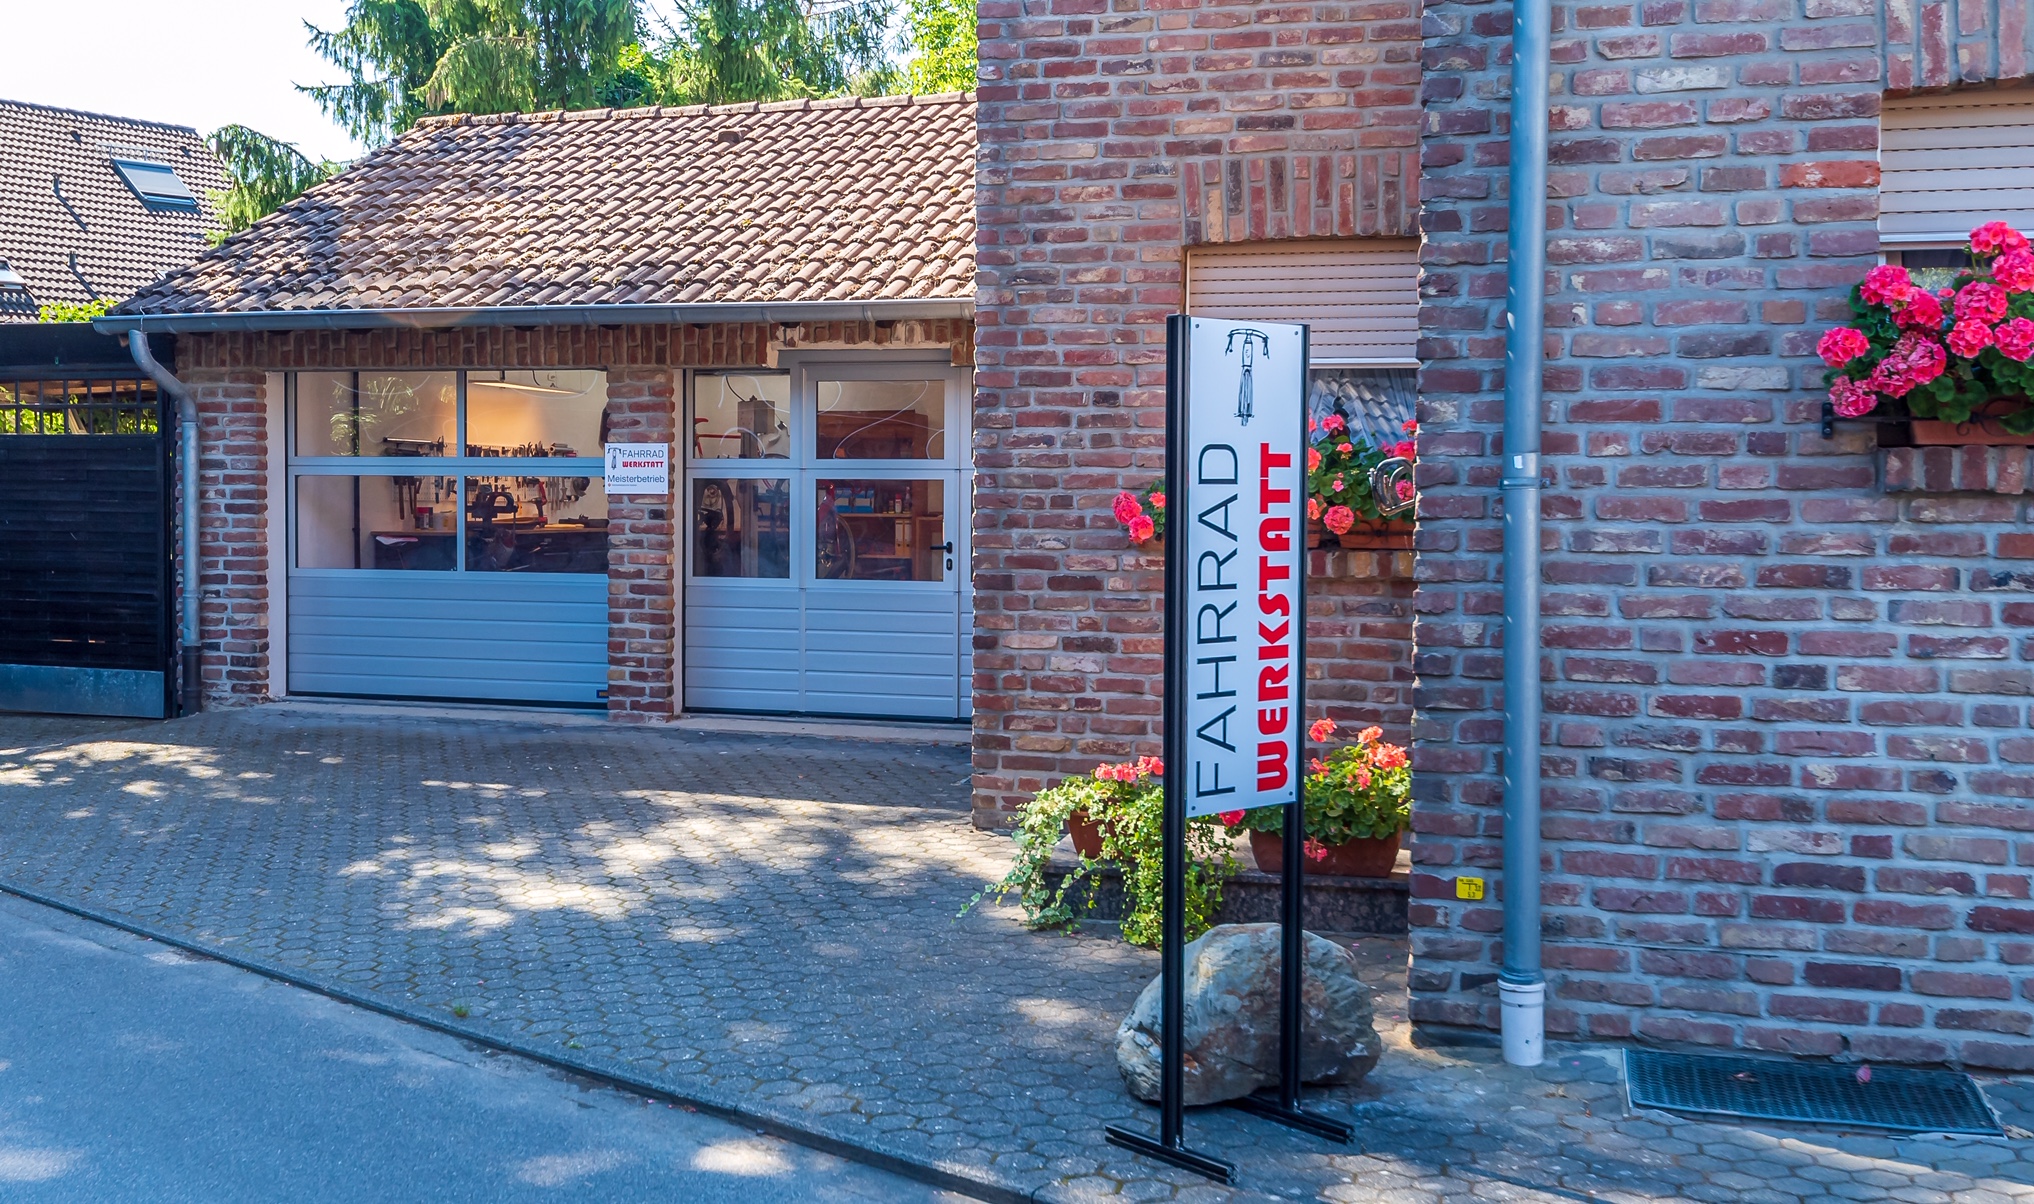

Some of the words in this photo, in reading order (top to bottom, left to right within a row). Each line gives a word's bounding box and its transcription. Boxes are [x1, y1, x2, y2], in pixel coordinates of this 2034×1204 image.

[607, 475, 665, 483] Meisterbetrieb
[622, 450, 664, 458] FAHRRAD
[1195, 442, 1239, 798] FAHRRAD
[1256, 442, 1292, 793] WERKSTATT
